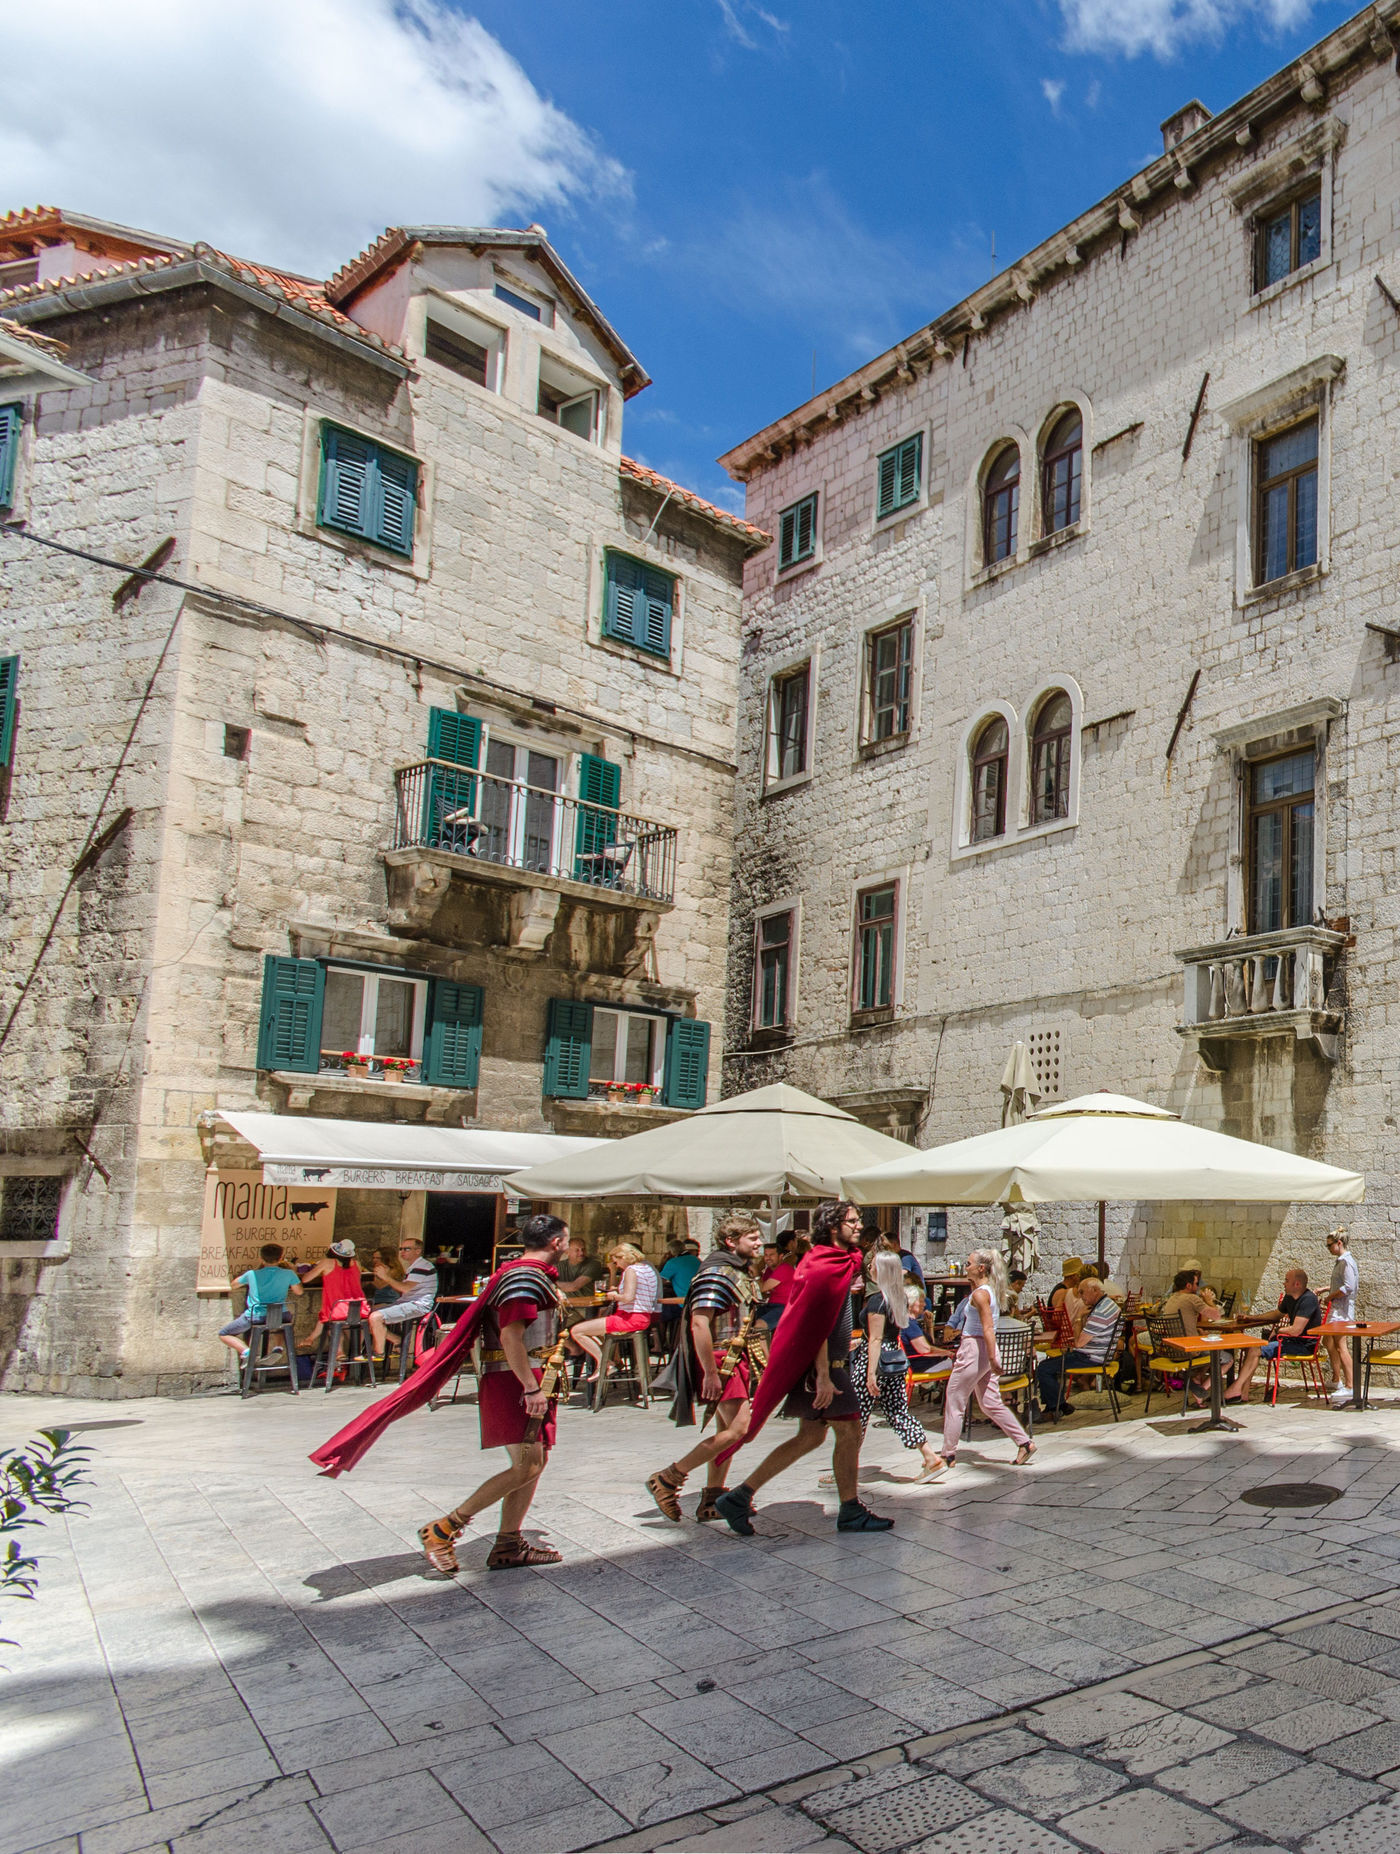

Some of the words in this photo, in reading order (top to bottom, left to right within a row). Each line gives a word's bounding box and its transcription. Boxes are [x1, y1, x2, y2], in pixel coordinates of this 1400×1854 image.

[343, 1169, 386, 1184] BURGERS
[395, 1171, 446, 1186] BREAKFAST
[457, 1174, 500, 1188] SAUSAGES
[213, 1181, 288, 1221] mama
[201, 1246, 262, 1260] BREAKFAST
